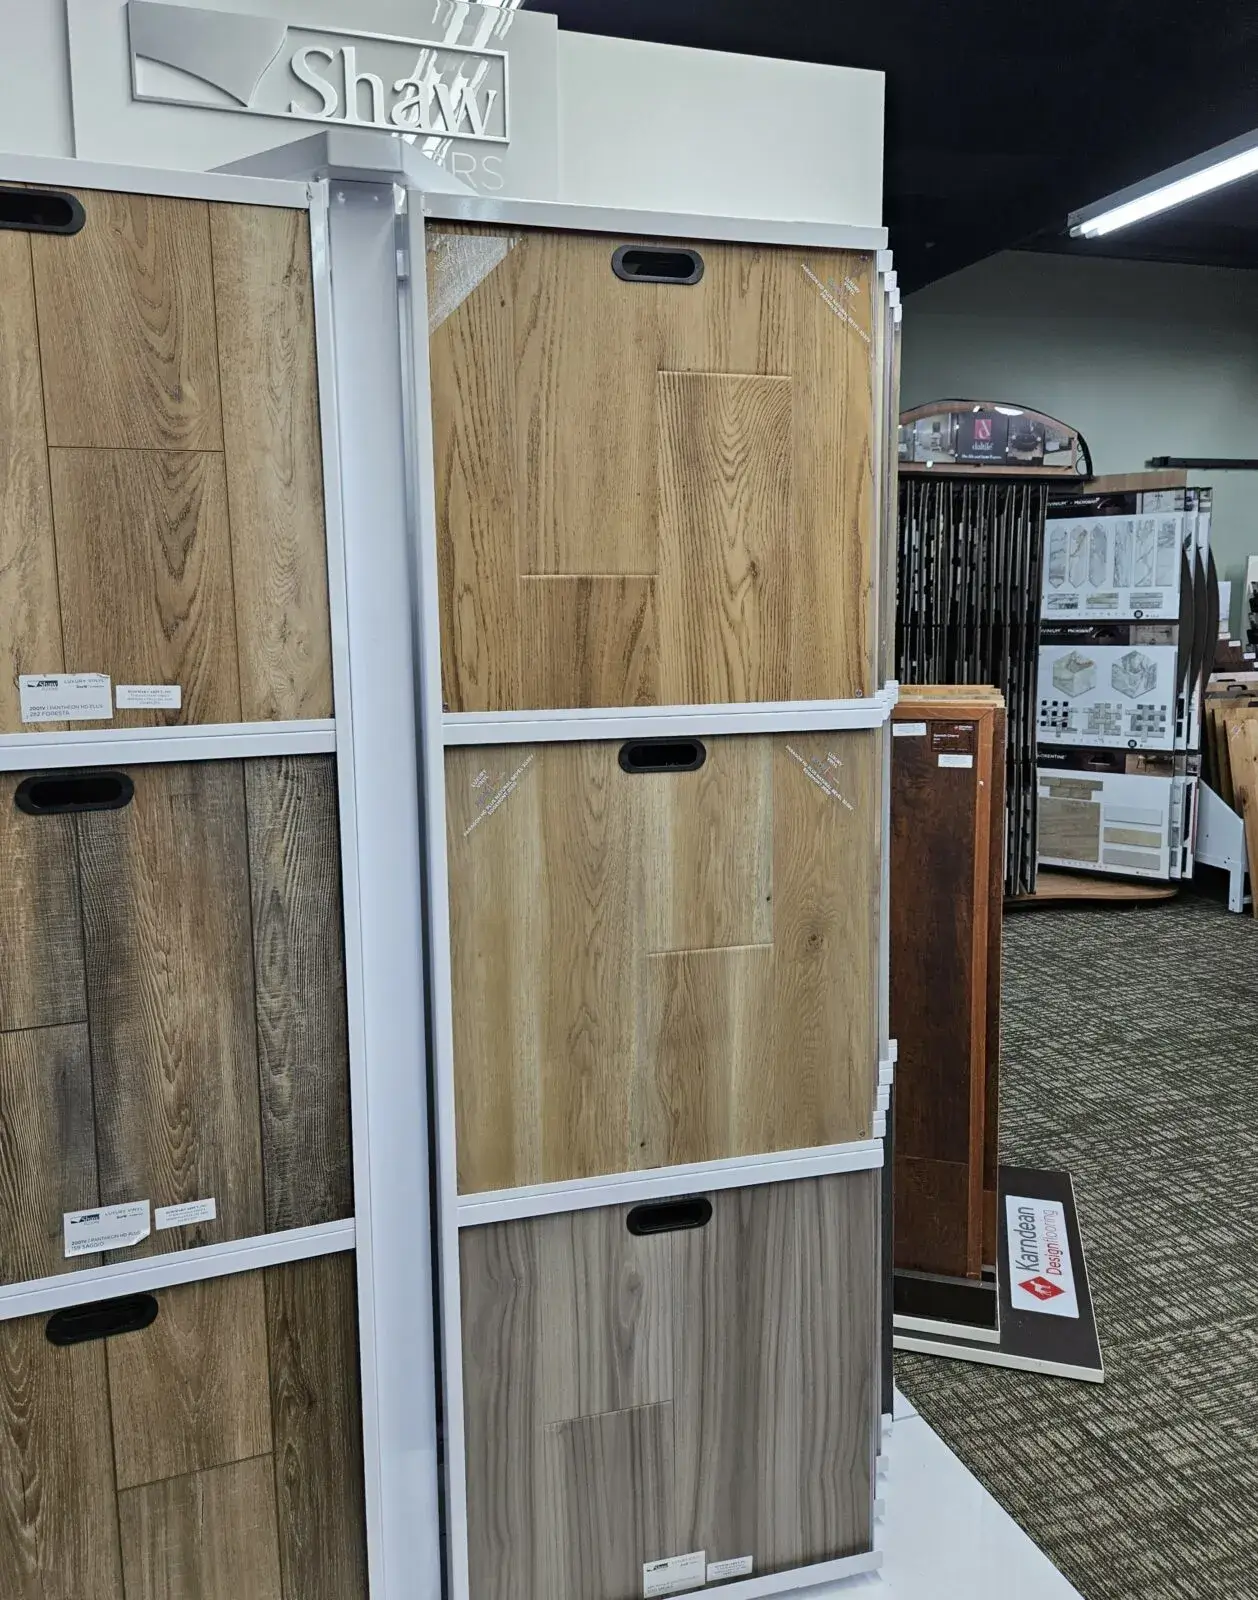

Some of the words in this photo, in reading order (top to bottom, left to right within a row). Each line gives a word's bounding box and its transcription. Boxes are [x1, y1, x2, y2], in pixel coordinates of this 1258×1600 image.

[289, 46, 498, 134] Shaw
[447, 151, 504, 191] RS
[1013, 1206, 1040, 1272] Karndean
[1043, 1209, 1062, 1275] Designflooring
